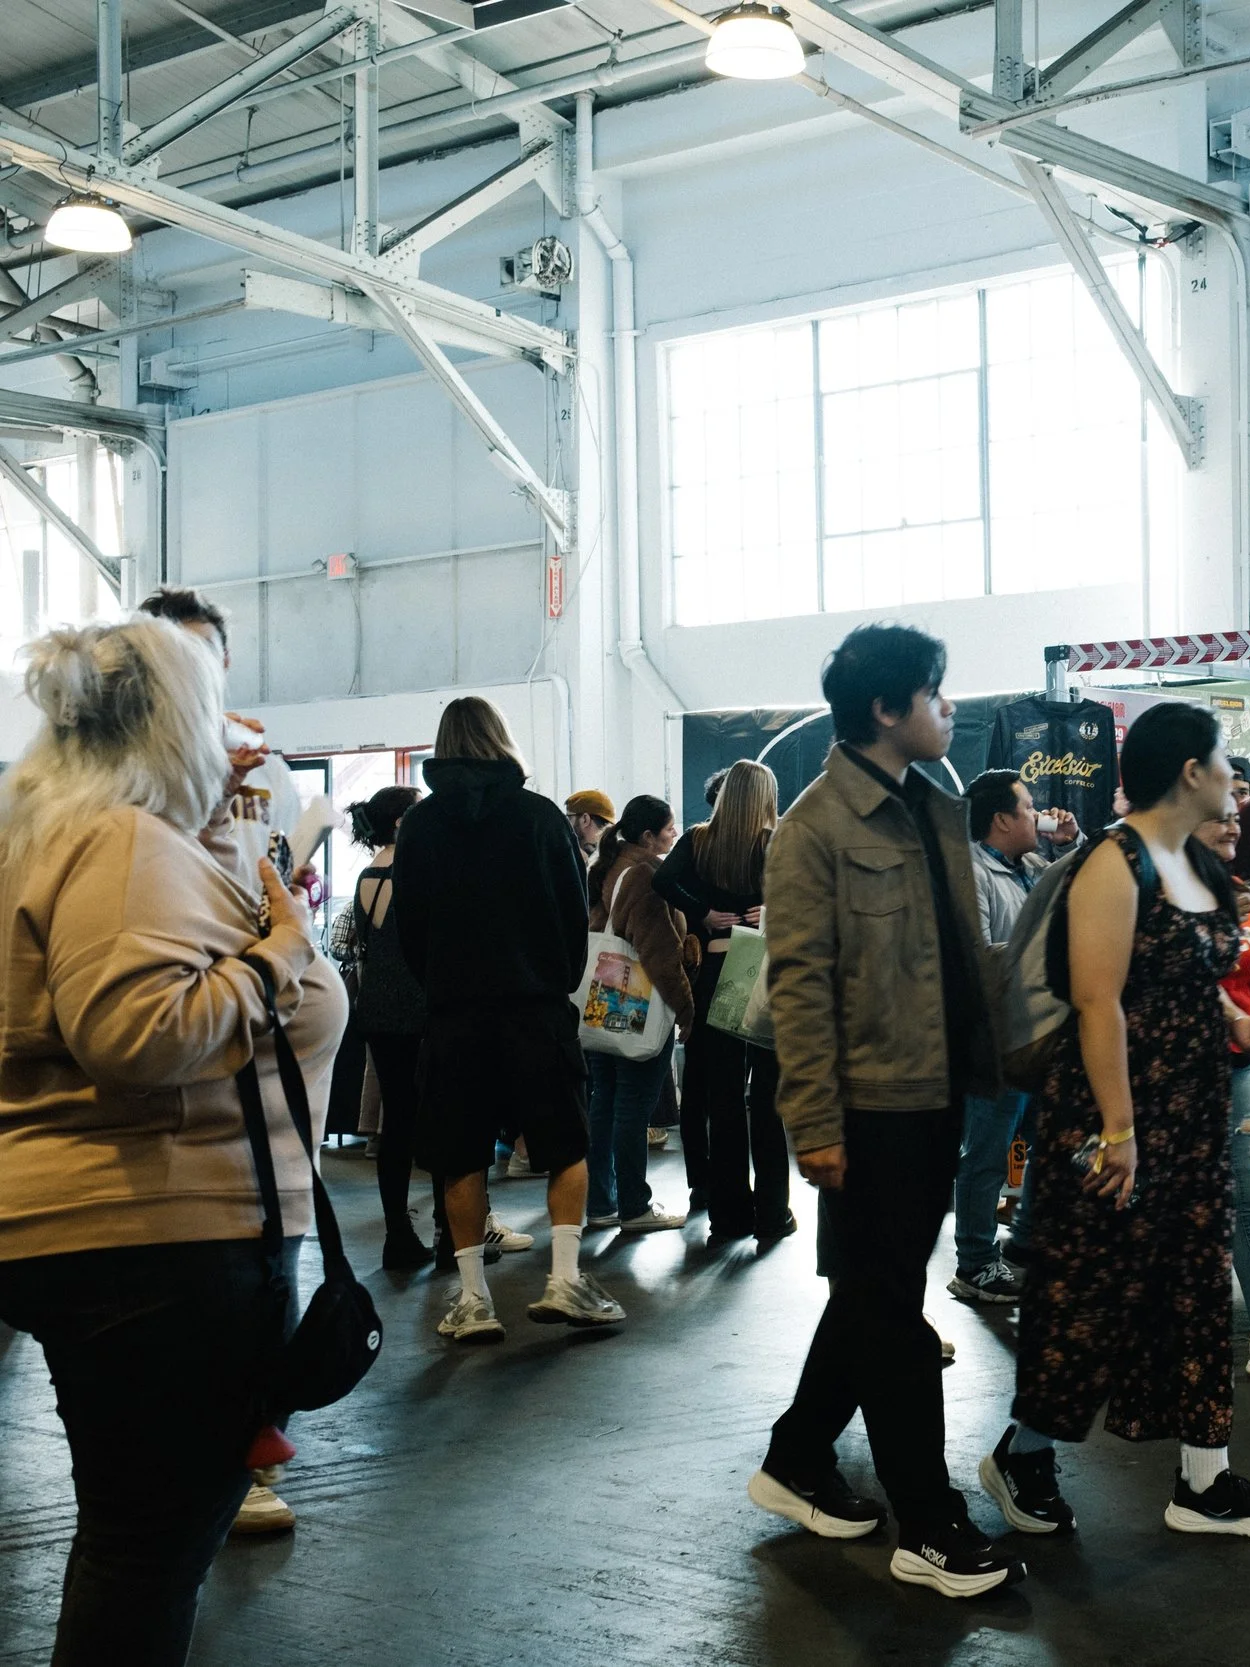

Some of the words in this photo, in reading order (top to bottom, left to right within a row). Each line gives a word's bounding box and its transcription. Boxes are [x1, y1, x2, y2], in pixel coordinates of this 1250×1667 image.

[1191, 277, 1207, 293] 24
[1020, 751, 1102, 784] Excelsior
[1063, 779, 1086, 788] COFFEE
[920, 1543, 947, 1569] HOKA
